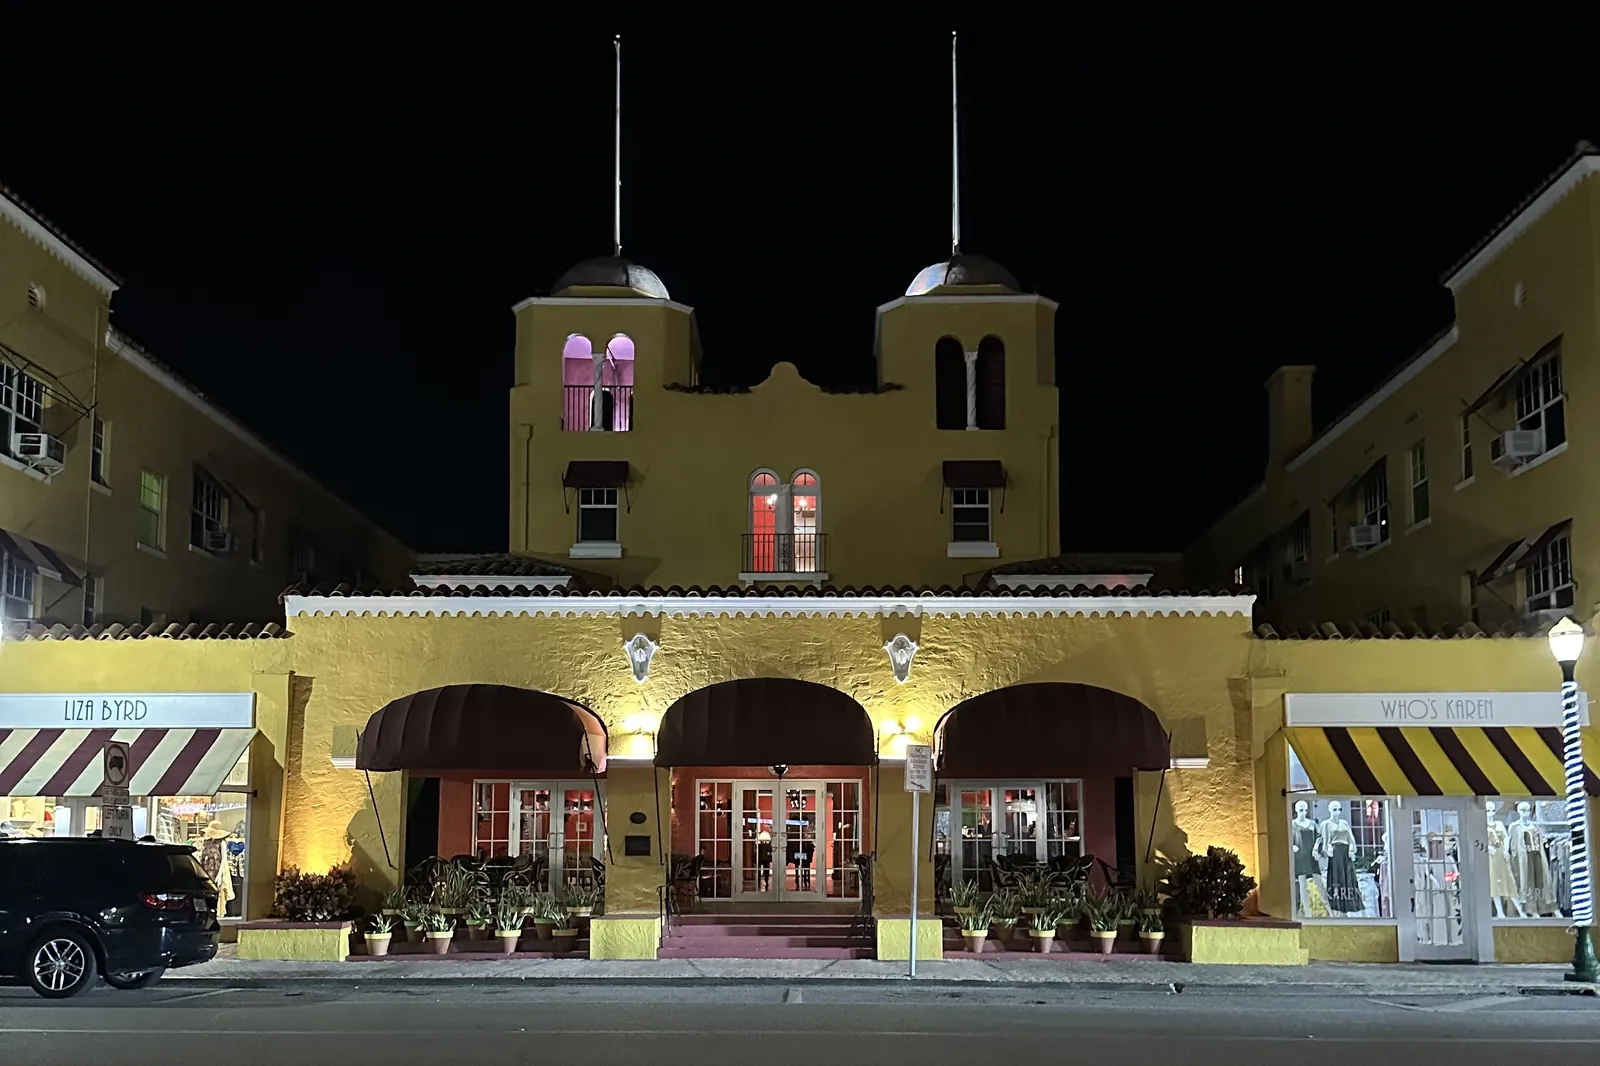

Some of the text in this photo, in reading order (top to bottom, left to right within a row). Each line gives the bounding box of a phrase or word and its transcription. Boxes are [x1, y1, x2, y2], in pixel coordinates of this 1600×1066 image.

[64, 699, 148, 721] LIZA BYRD
[1380, 698, 1494, 720] WHO'S KAREN
[104, 808, 130, 821] LEFT TURN
[108, 825, 123, 837] ONLY
